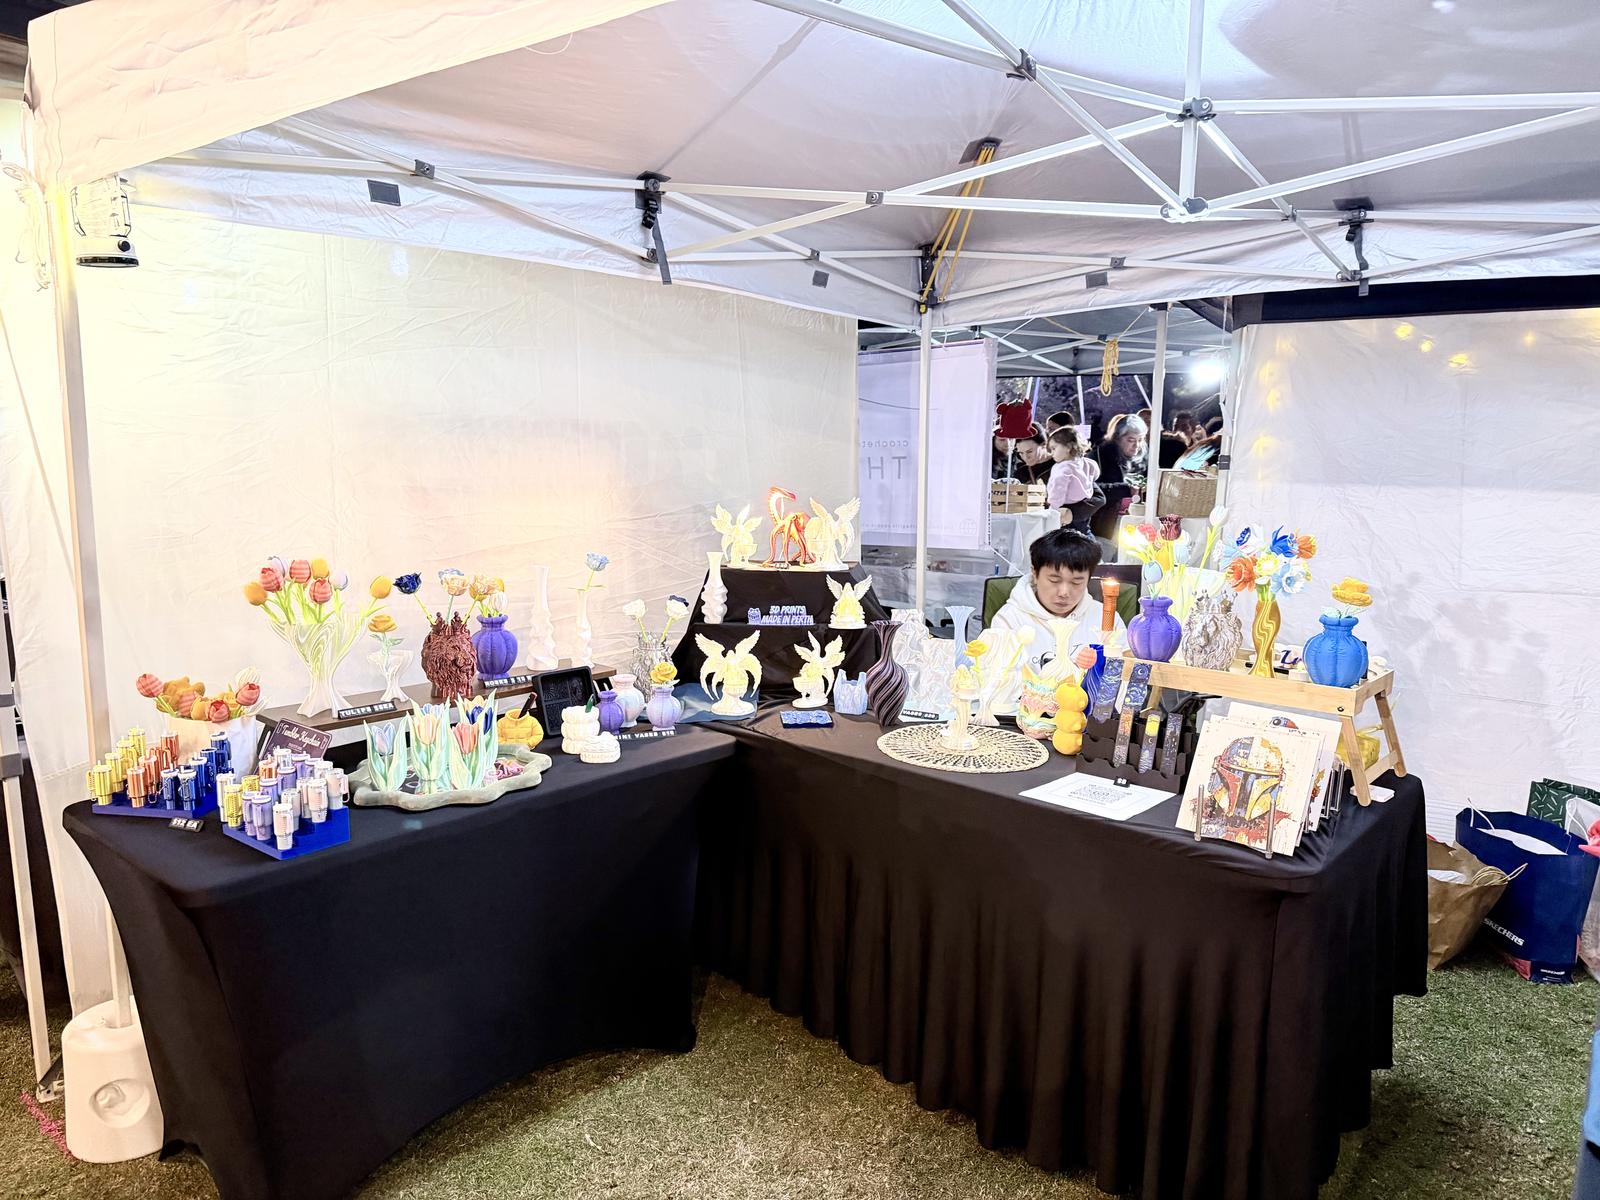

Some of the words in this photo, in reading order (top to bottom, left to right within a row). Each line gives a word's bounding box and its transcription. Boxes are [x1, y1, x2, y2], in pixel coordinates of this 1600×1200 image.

[781, 605, 806, 614] PRINTS
[761, 615, 782, 625] MADE
[791, 615, 814, 625] PERTH
[340, 706, 371, 717] TULIPS
[1483, 918, 1525, 946] SKECHERS
